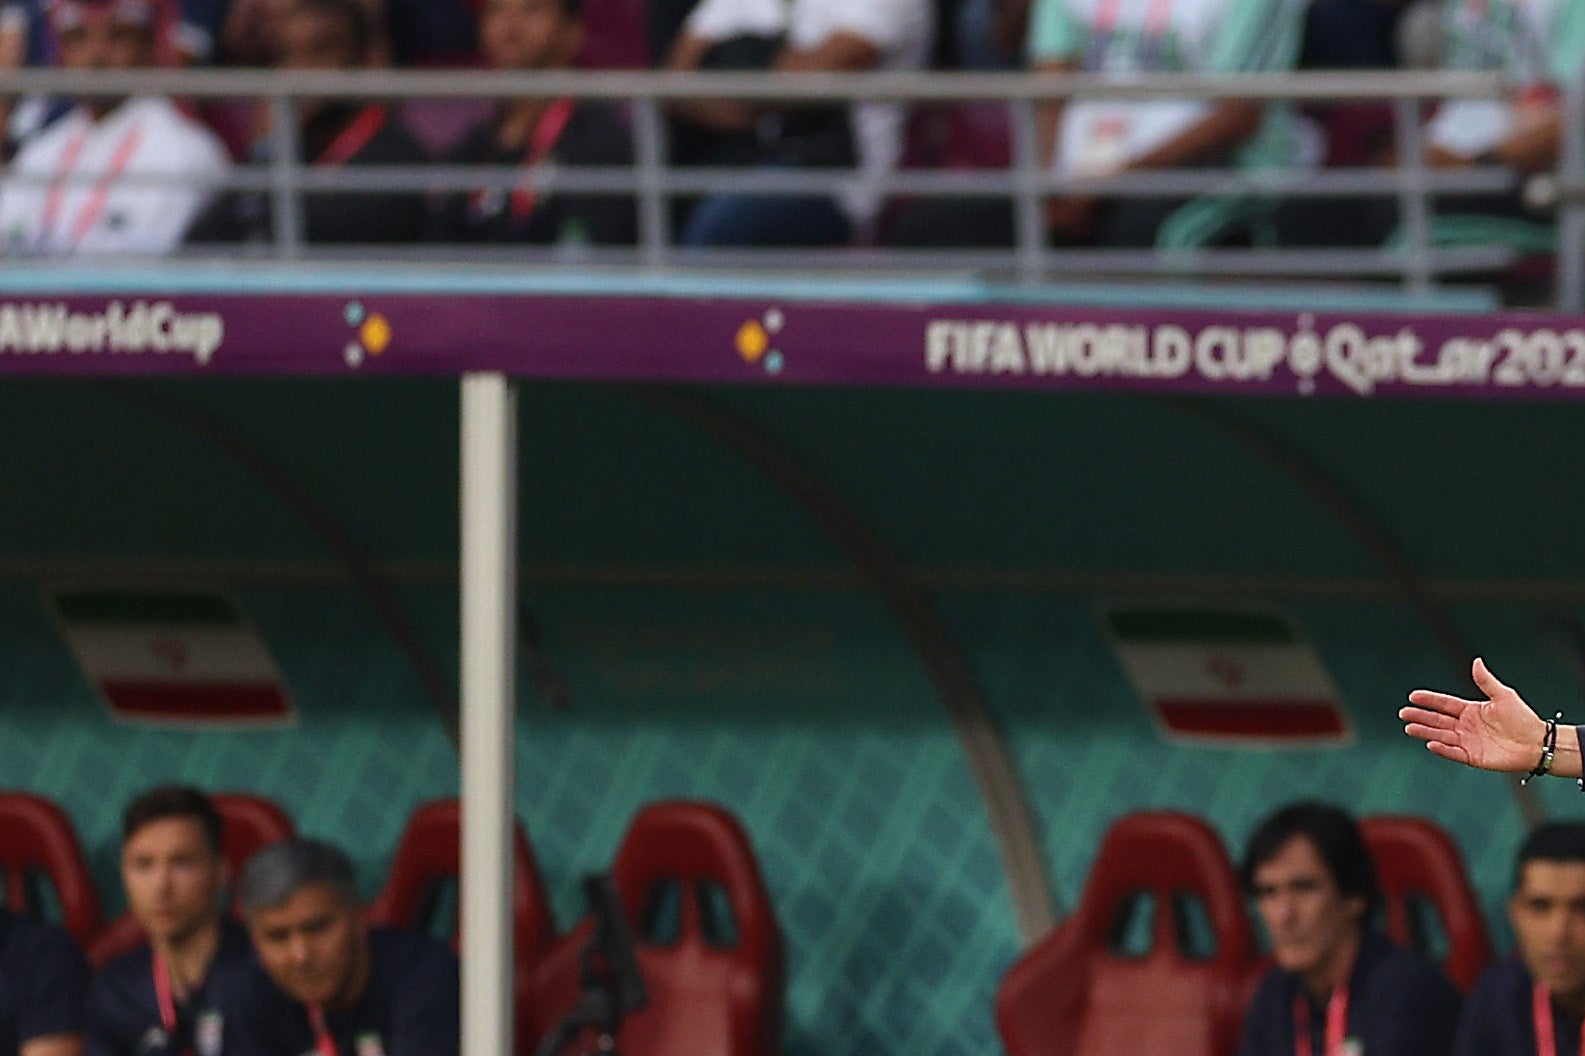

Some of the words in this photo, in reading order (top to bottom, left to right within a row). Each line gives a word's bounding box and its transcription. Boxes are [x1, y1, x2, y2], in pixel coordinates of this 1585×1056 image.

[926, 319, 1025, 375] FIFA
[1025, 322, 1193, 380] WORLD
[1194, 325, 1287, 381] CUP
